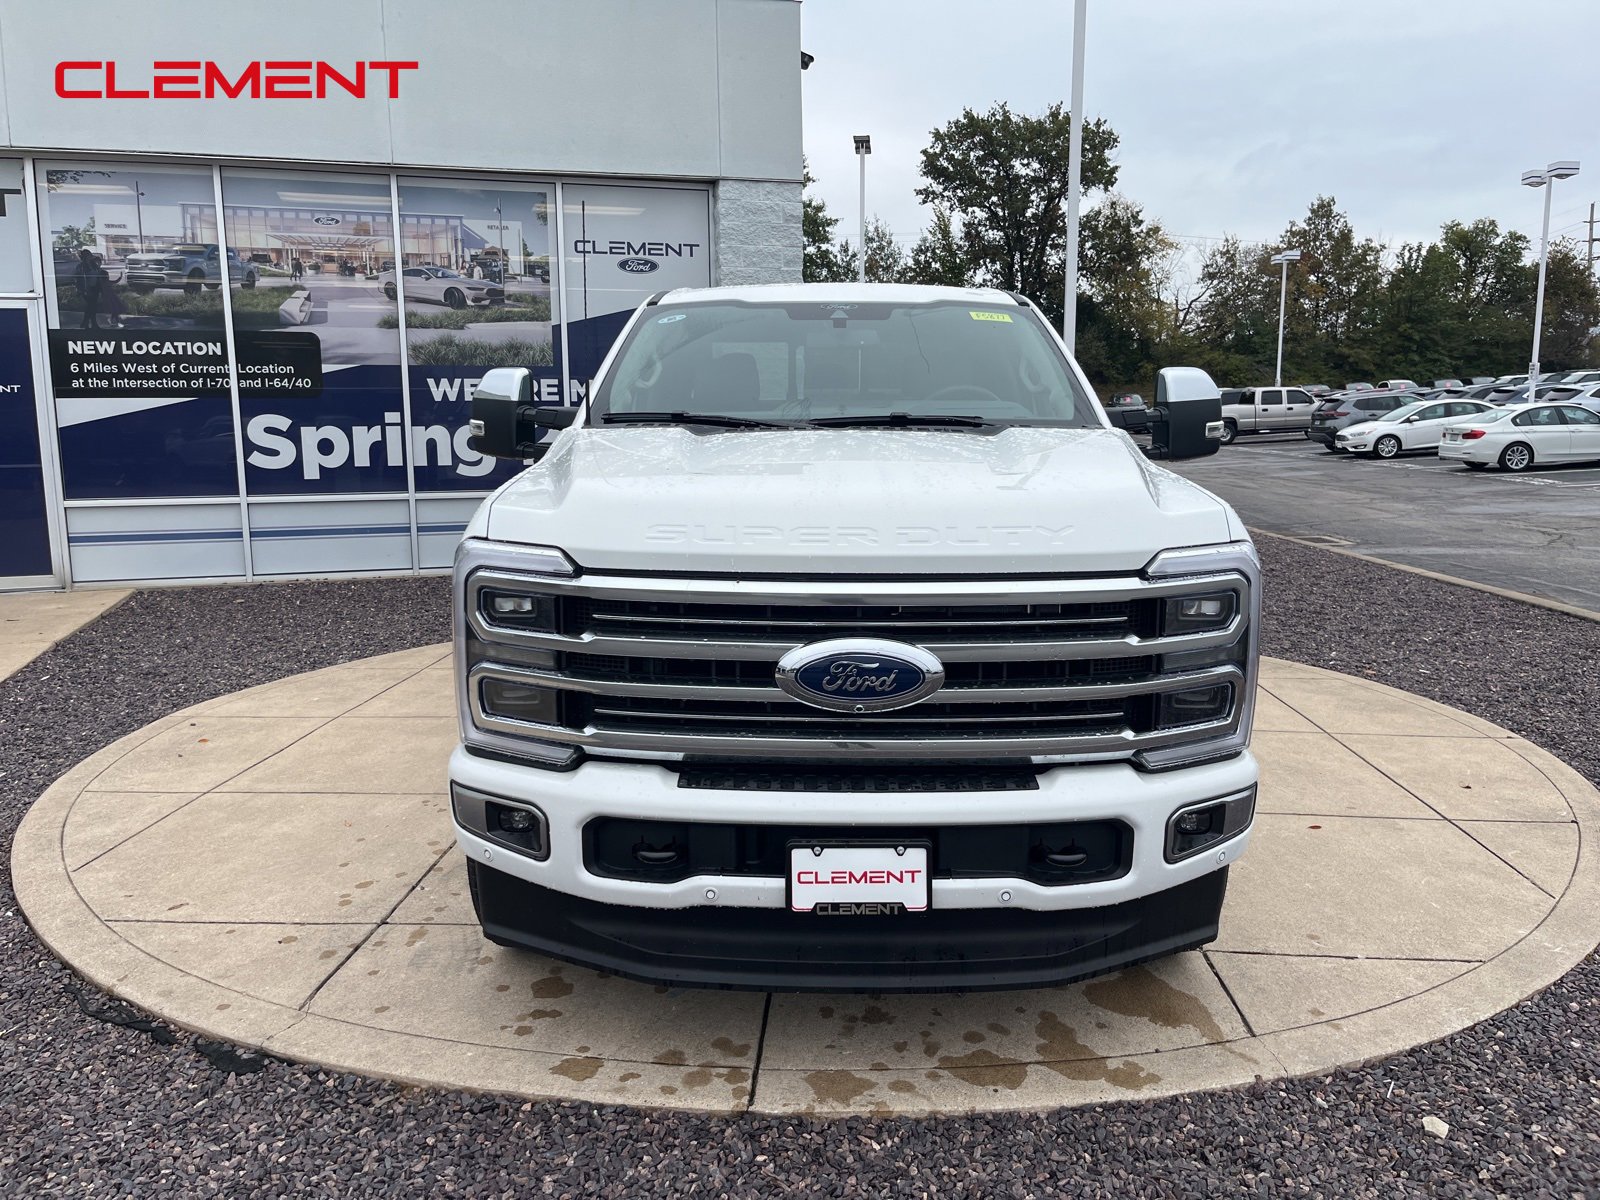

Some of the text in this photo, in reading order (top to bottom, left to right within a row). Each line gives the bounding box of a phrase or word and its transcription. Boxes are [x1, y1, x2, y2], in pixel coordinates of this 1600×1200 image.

[574, 239, 700, 258] CLEMENT
[625, 259, 651, 272] Ford
[68, 341, 222, 356] NEW LOCATION
[70, 362, 294, 374] 6 Miles West of Current Location
[71, 377, 312, 390] at the Intersection of I-70 and I-64/40
[247, 412, 497, 479] Spring
[645, 524, 1075, 546] SUPER DUTY
[822, 660, 898, 692] Ford
[797, 870, 922, 884] CLEMENT
[816, 903, 901, 915] CLEMENT
